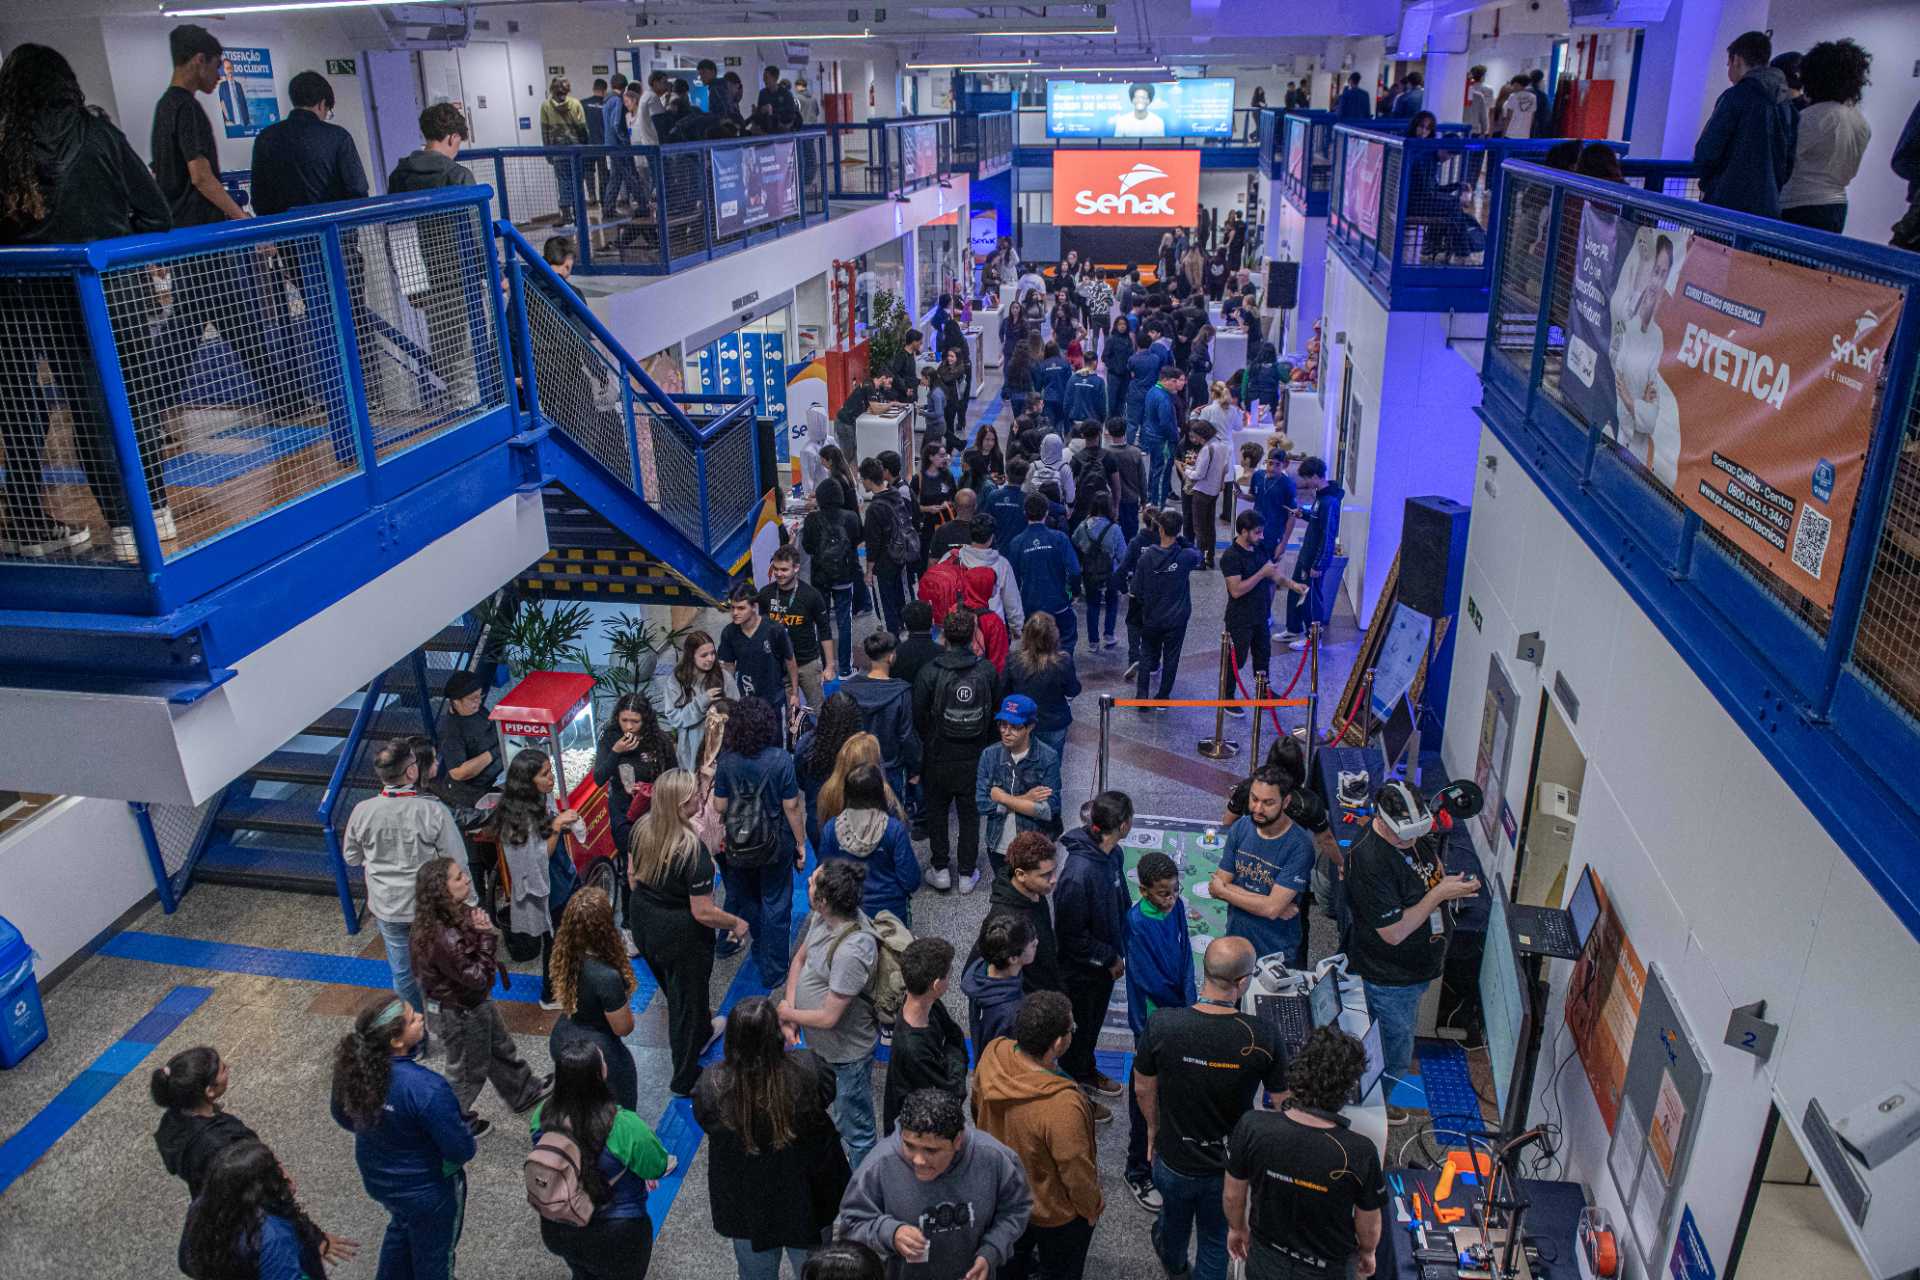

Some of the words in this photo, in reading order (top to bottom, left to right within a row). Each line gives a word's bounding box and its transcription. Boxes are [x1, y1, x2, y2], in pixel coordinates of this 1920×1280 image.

[222, 49, 261, 65] ATISFAÇÃO
[245, 64, 269, 73] CLIENTE
[1074, 190, 1176, 215] Senac
[1721, 300, 1762, 325] PRESENCIAL
[1676, 322, 1790, 411] ESTÉTICA
[1712, 453, 1737, 476] Senac
[1736, 467, 1761, 493] Curitiba
[1764, 486, 1795, 512] Centro
[1727, 482, 1746, 502] 0800
[1527, 647, 1535, 659] 3
[504, 723, 549, 734] PIPOCA
[1742, 1031, 1757, 1049] 2
